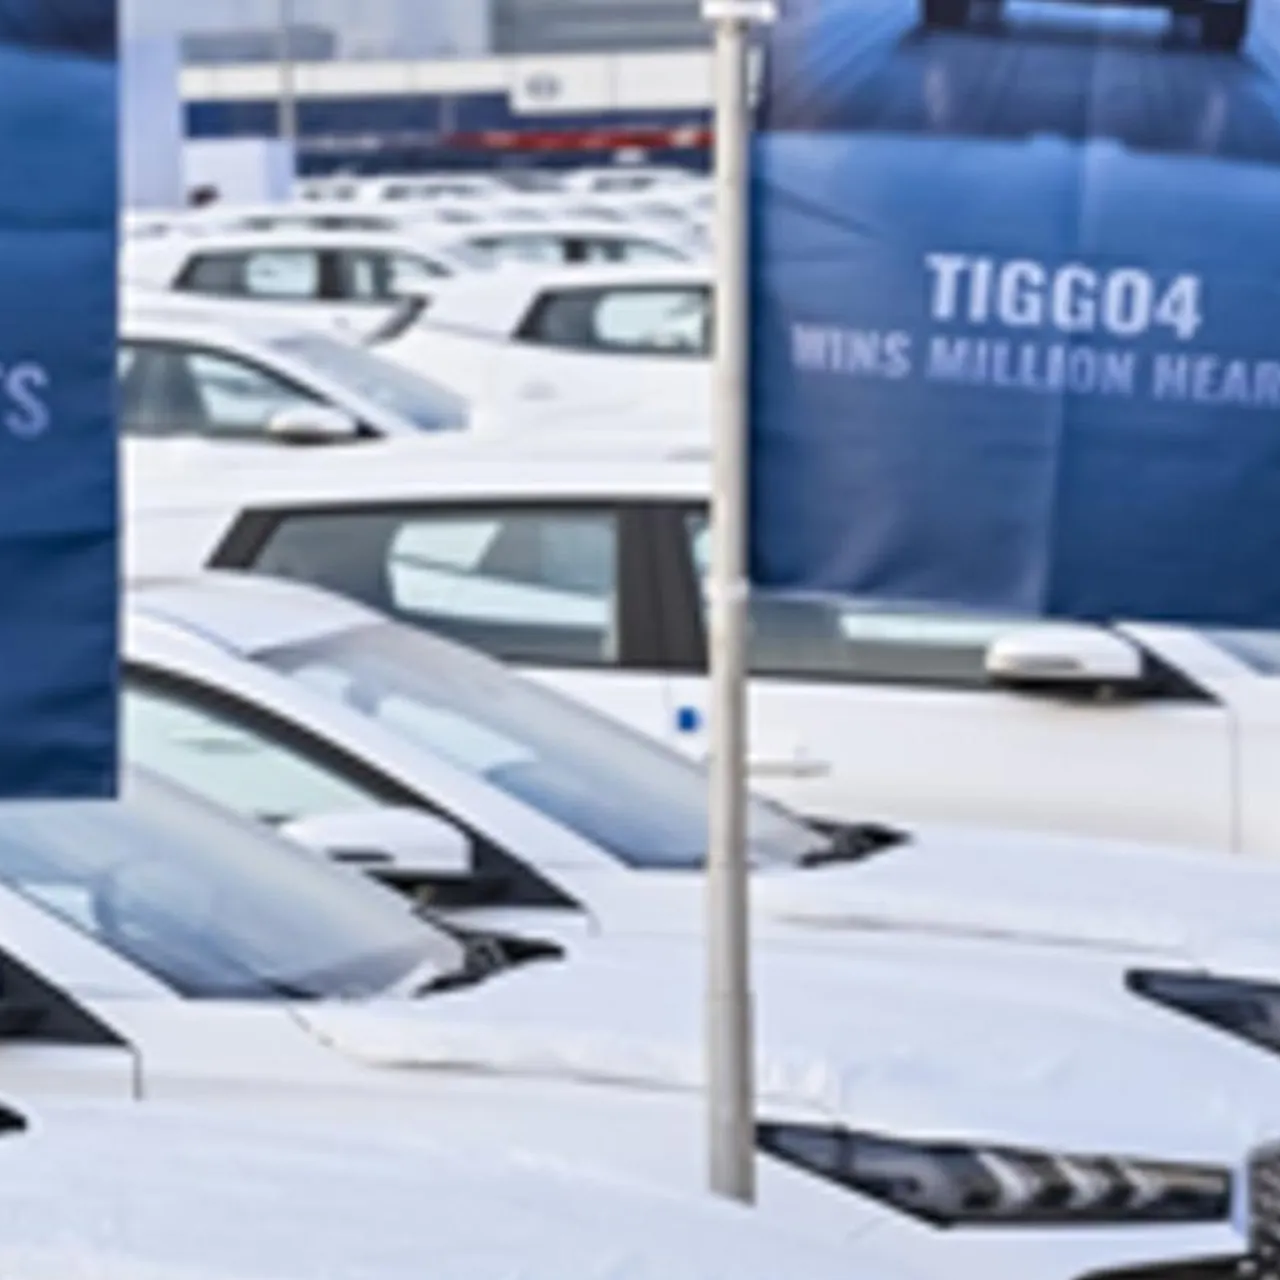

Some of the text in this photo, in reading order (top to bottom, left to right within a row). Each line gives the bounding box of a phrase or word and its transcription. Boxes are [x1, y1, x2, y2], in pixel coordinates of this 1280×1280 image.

[925, 252, 1204, 341] TIGGO4
[790, 324, 912, 379] WINS
[924, 337, 1136, 397] MILLION
